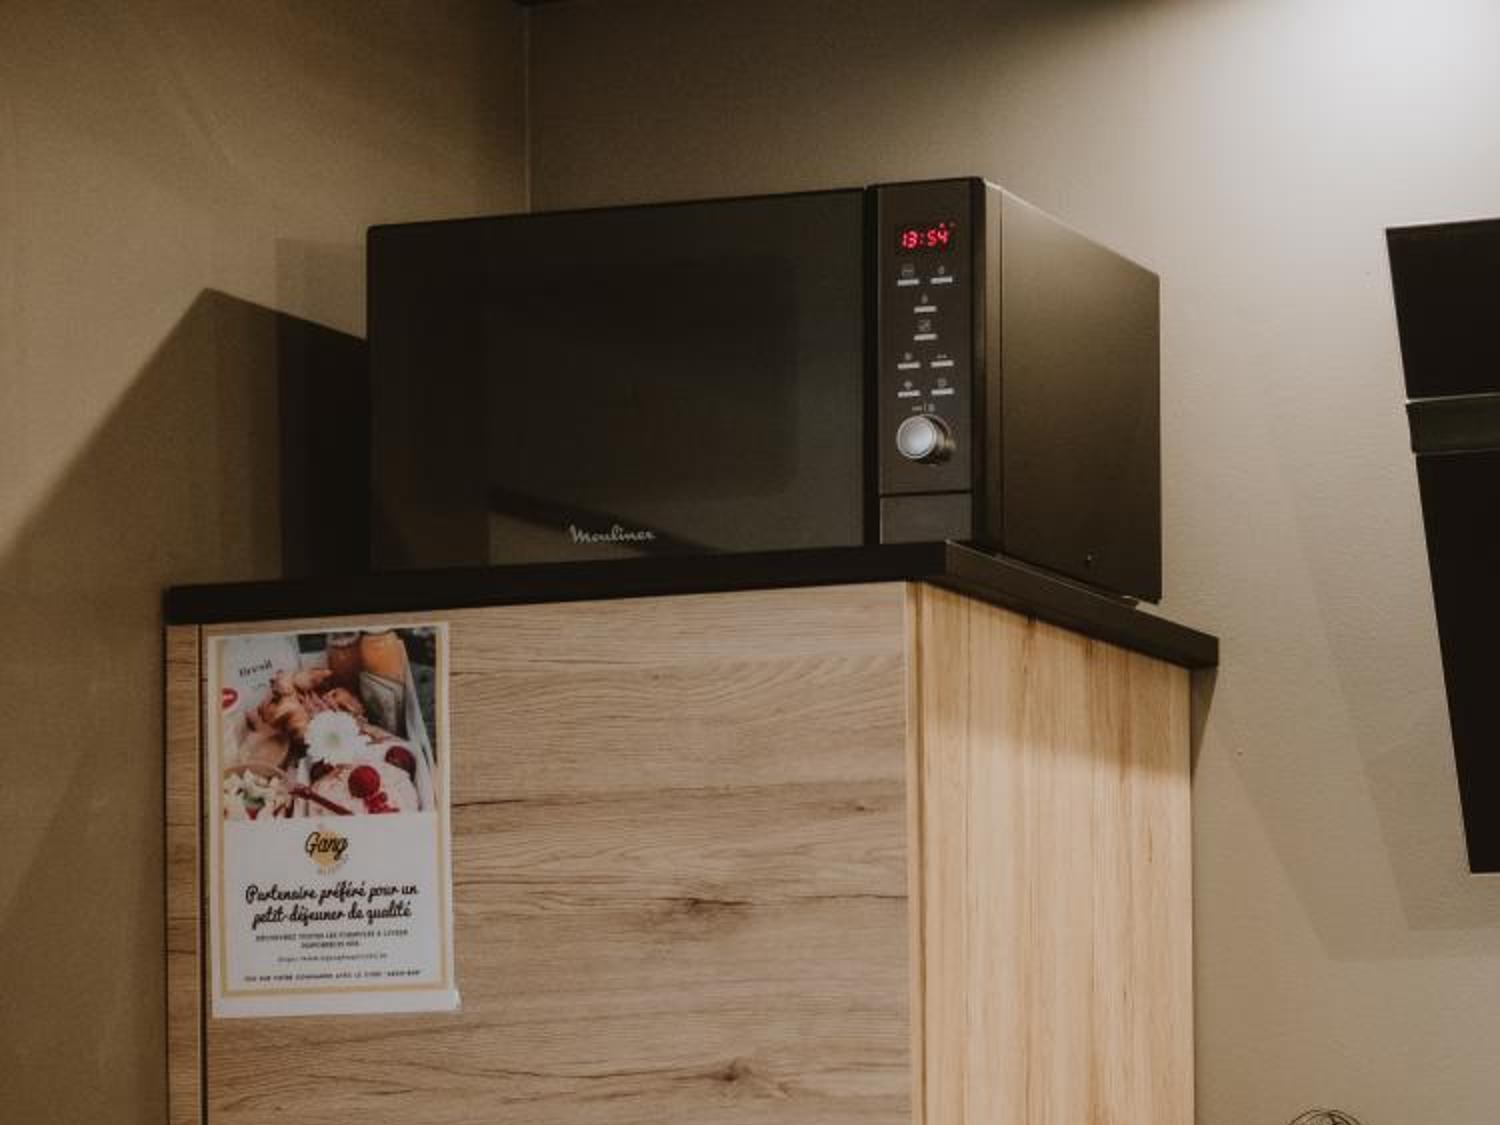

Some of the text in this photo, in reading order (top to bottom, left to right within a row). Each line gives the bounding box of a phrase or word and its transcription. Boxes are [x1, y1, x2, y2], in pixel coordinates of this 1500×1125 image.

[902, 223, 948, 248] 13:54
[245, 880, 417, 905] Partenaire préféré pour un
[251, 899, 412, 931] petit déjeuner de qualité
